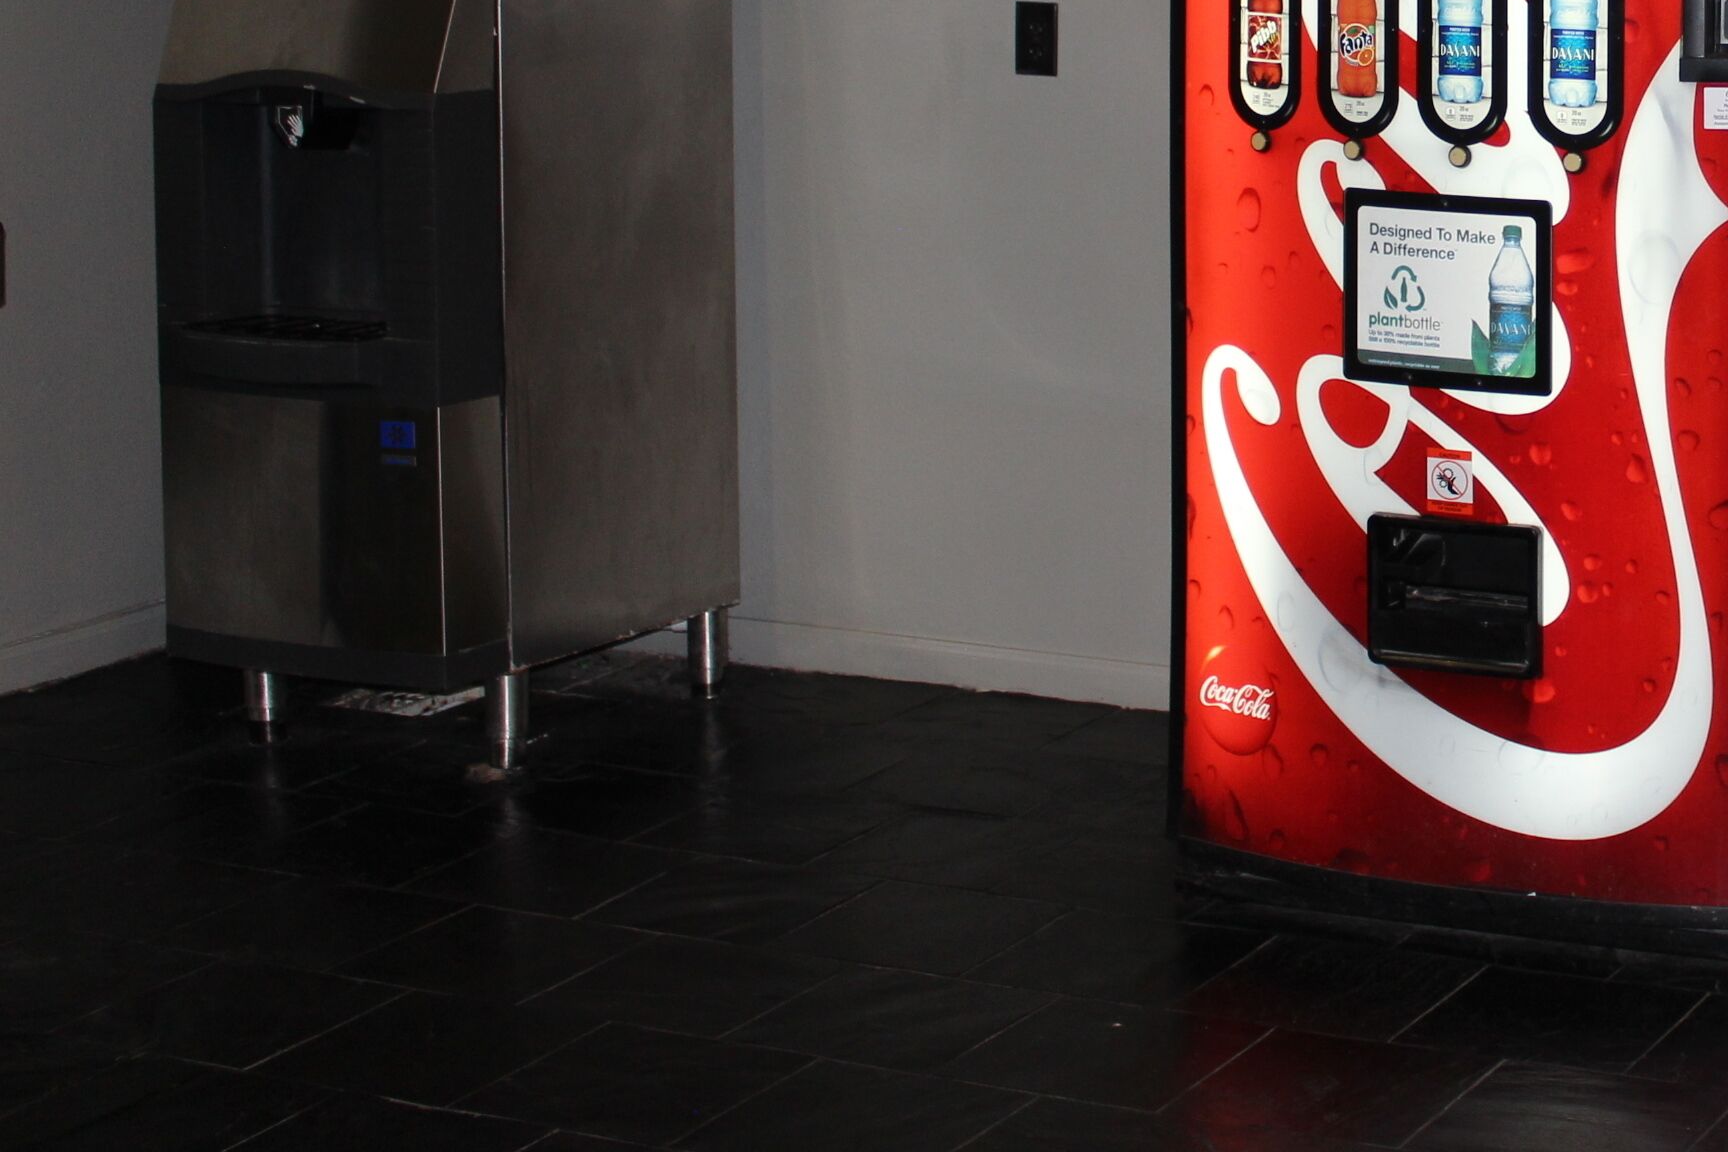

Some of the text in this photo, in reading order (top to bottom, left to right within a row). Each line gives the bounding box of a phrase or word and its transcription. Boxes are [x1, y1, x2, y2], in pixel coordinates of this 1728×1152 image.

[1250, 20, 1277, 53] Pibb
[1339, 31, 1373, 56] Fanta
[1440, 40, 1480, 57] DASANI
[1552, 45, 1594, 61] DASANI
[1369, 222, 1496, 245] Designed To Make
[1370, 241, 1455, 260] A Difference
[1369, 312, 1441, 331] plantbottle
[1199, 675, 1275, 721] Coca-Cola
